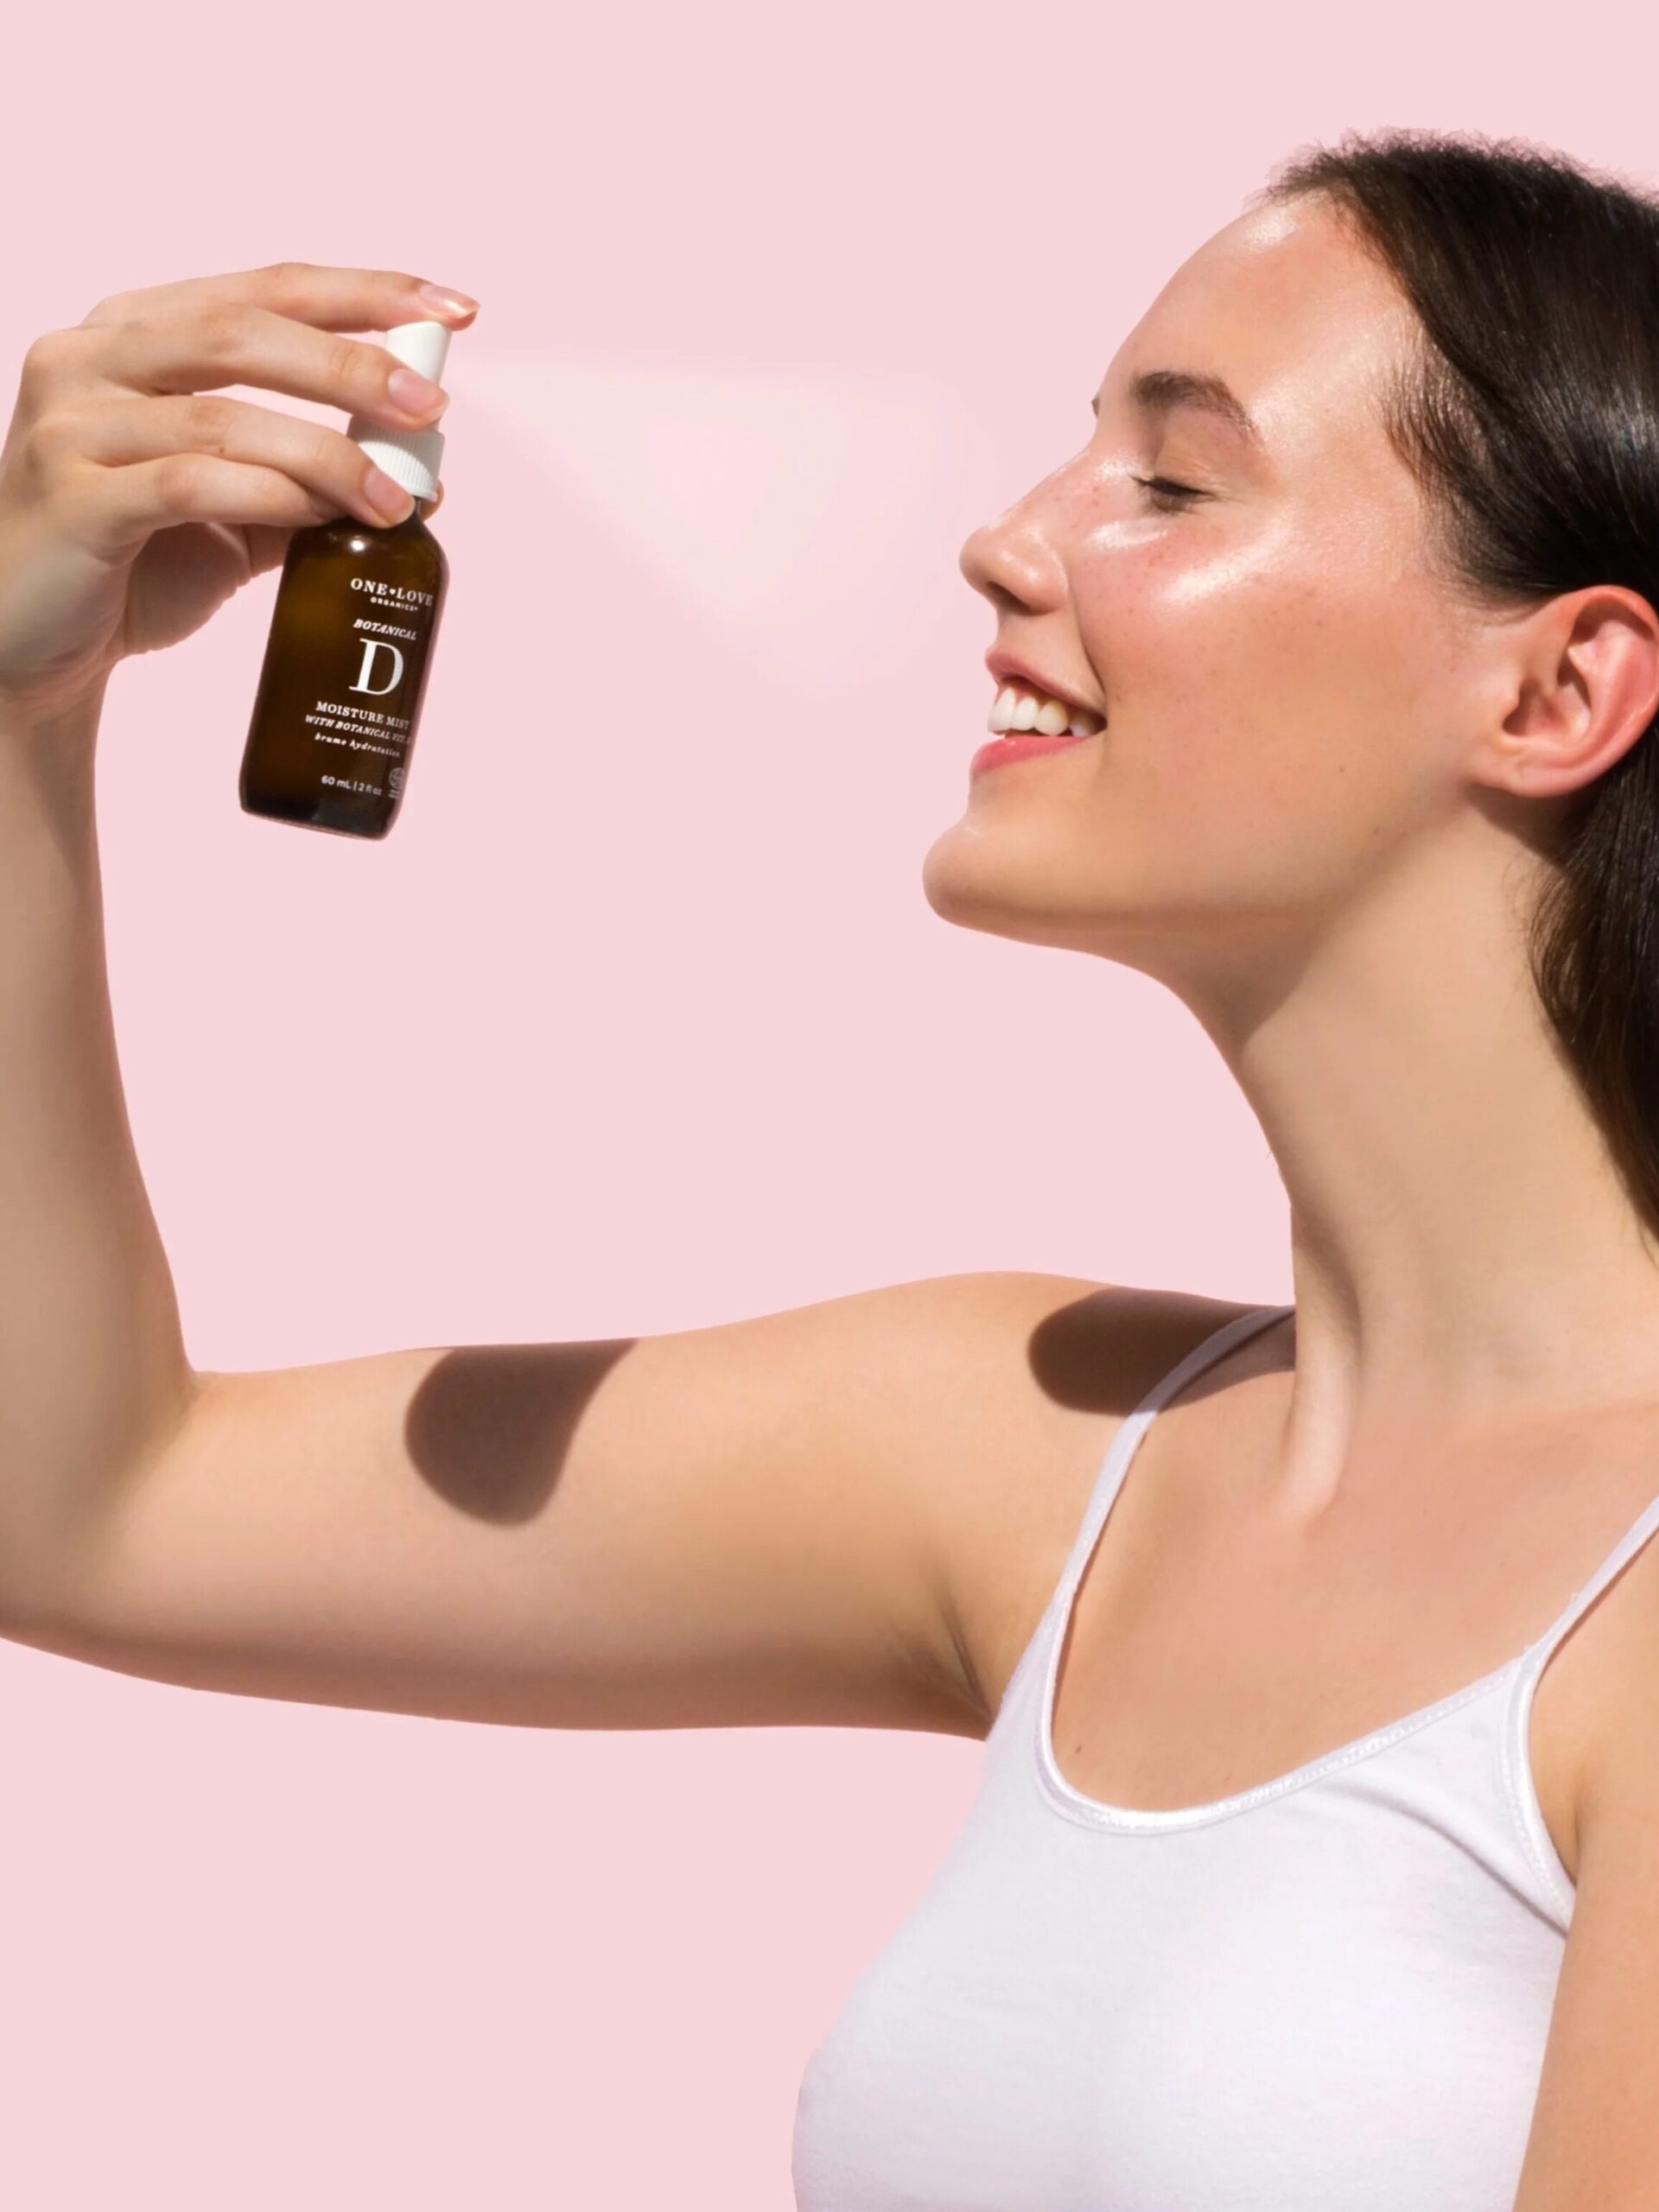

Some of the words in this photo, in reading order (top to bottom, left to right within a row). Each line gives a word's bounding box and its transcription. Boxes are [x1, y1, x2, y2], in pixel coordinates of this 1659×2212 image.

[350, 577, 388, 596] ONE
[396, 587, 434, 607] LOVE
[353, 618, 417, 640] BOTANICAL
[348, 638, 404, 696] D
[305, 715, 334, 728] WITH
[335, 720, 391, 741] BOTANICAL
[315, 701, 385, 723] MOISTURE
[385, 715, 410, 730] MIST
[314, 733, 347, 746] brume
[349, 740, 400, 757] hydratation
[321, 774, 335, 785] 60
[336, 779, 352, 790] mL
[358, 783, 365, 792] 2
